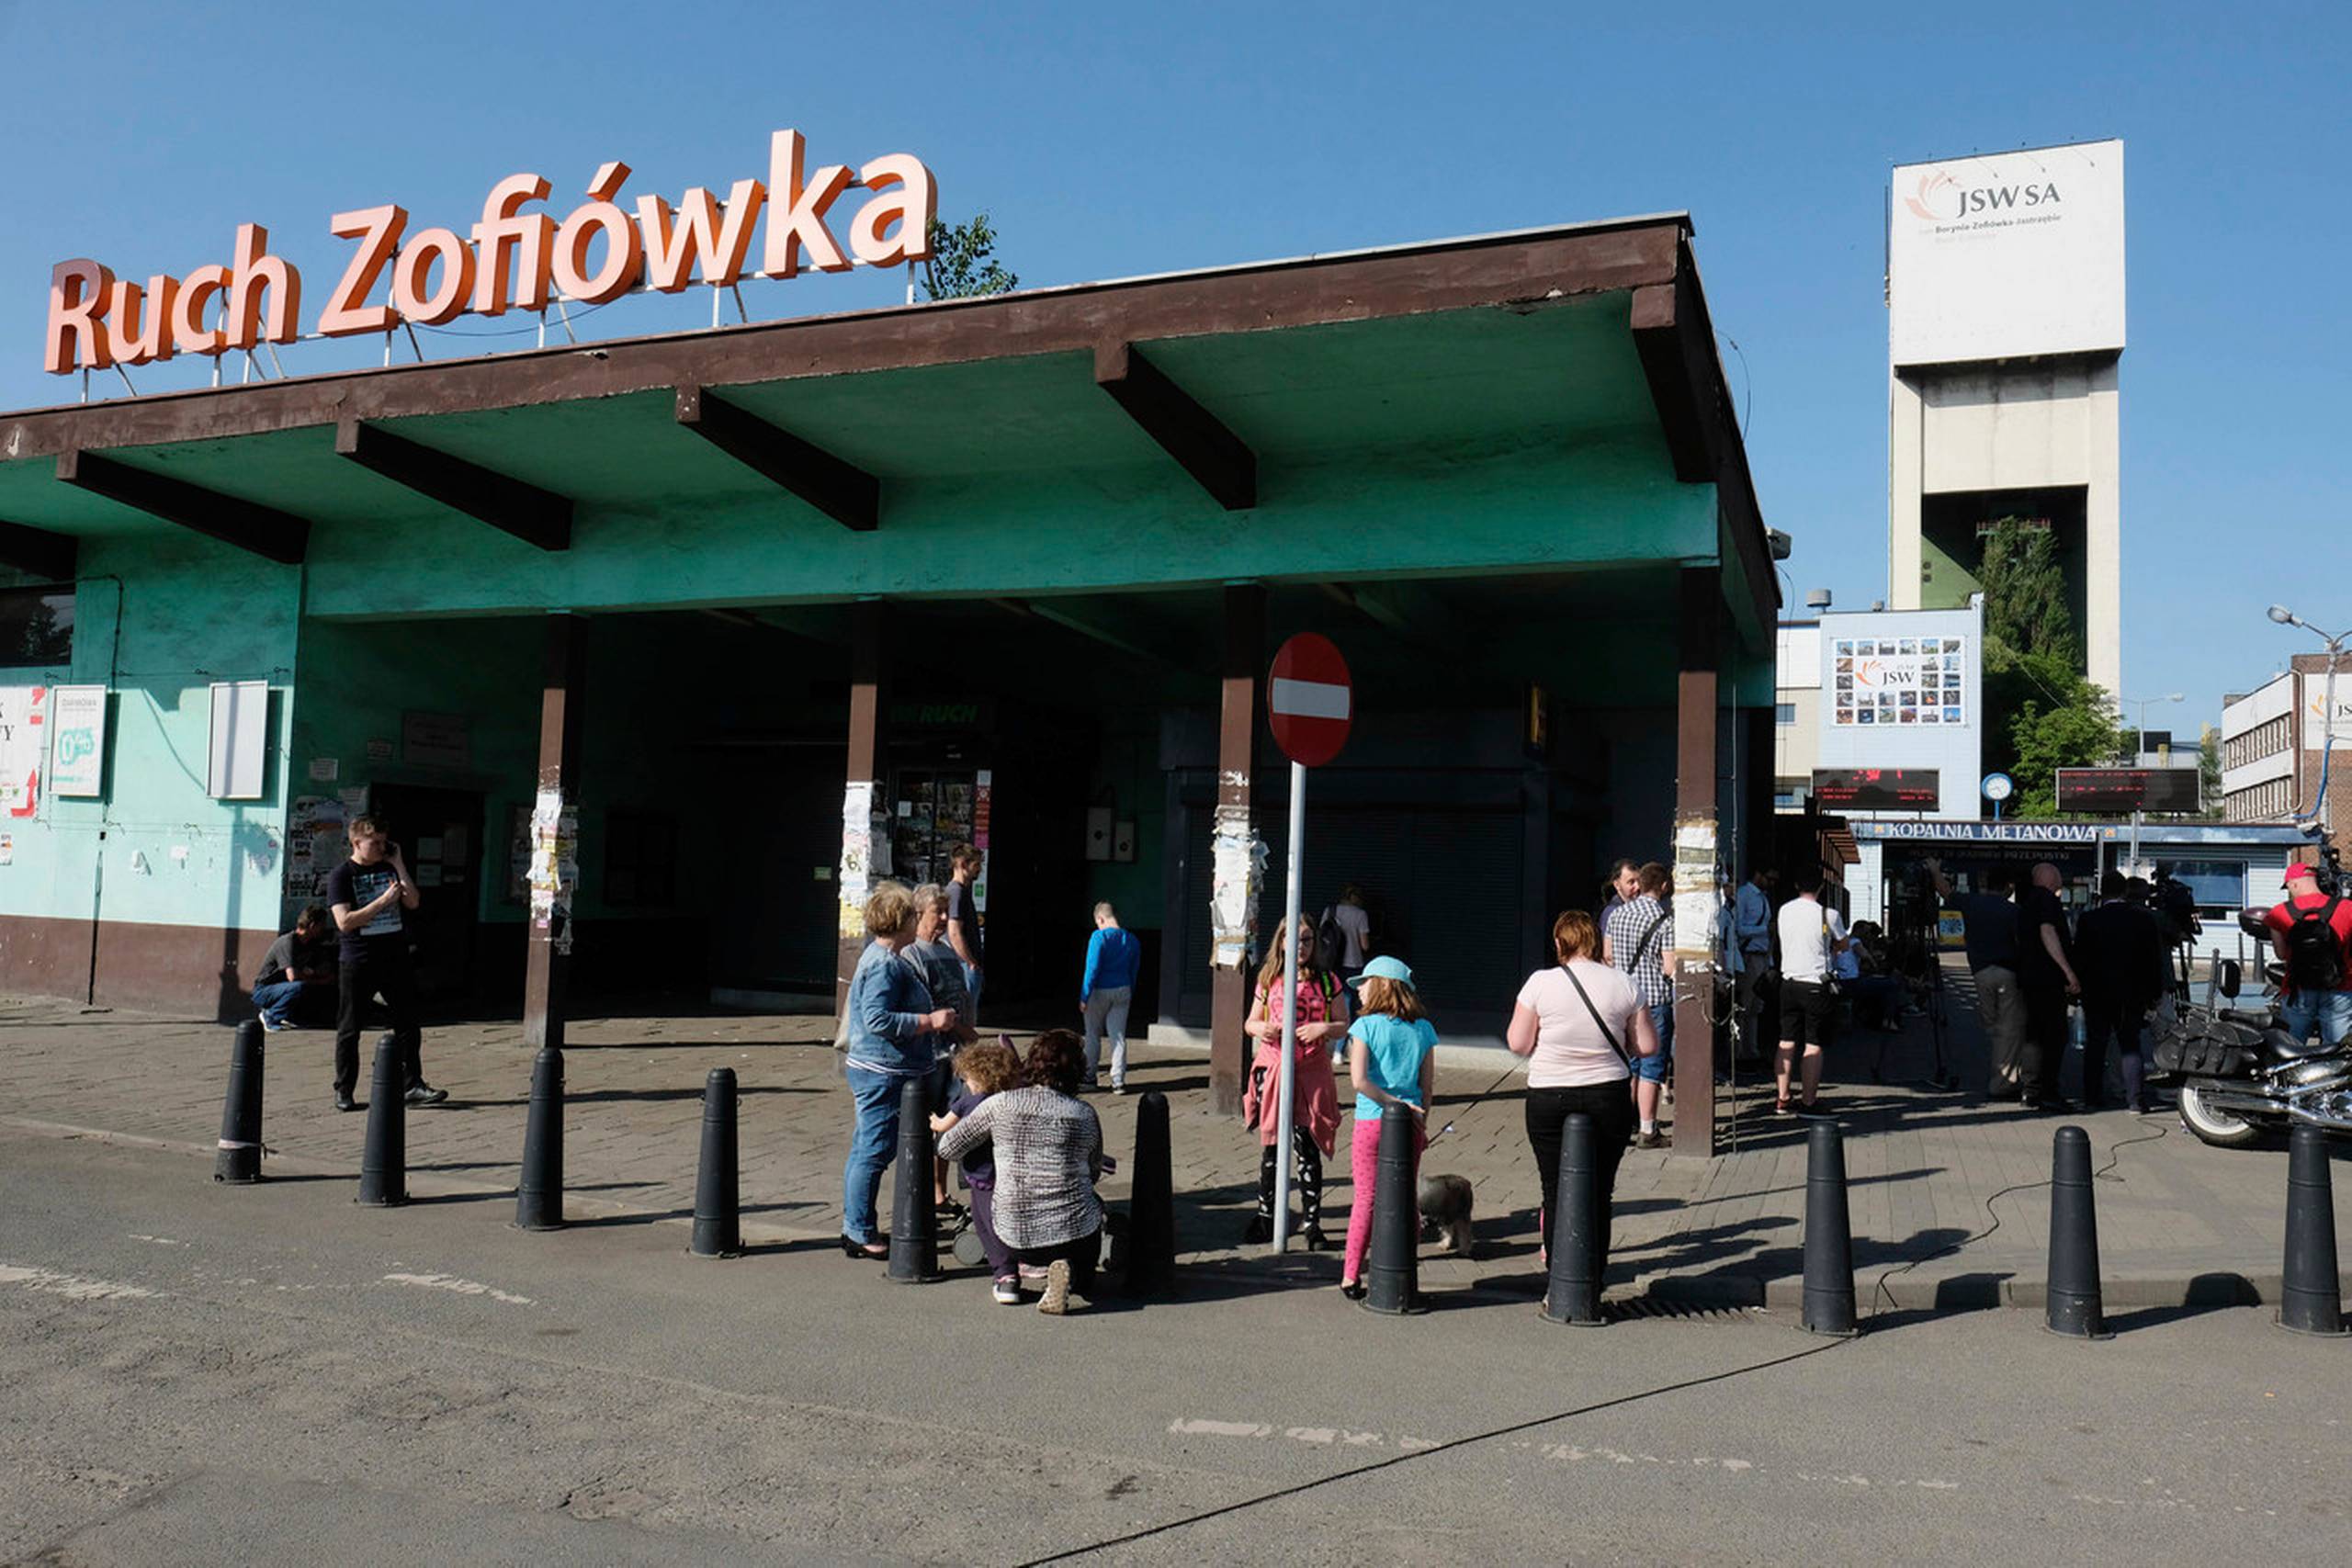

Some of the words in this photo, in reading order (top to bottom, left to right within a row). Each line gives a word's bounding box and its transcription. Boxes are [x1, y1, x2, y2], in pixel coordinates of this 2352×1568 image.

[1957, 185, 2019, 219] JSW
[2025, 183, 2061, 207] SA
[45, 223, 301, 375] Ruch
[318, 129, 937, 338] Zofiówka
[1883, 671, 1915, 685] JSW
[1889, 823, 1973, 839] KOPALNIA
[1981, 825, 2097, 840] METANOWA
